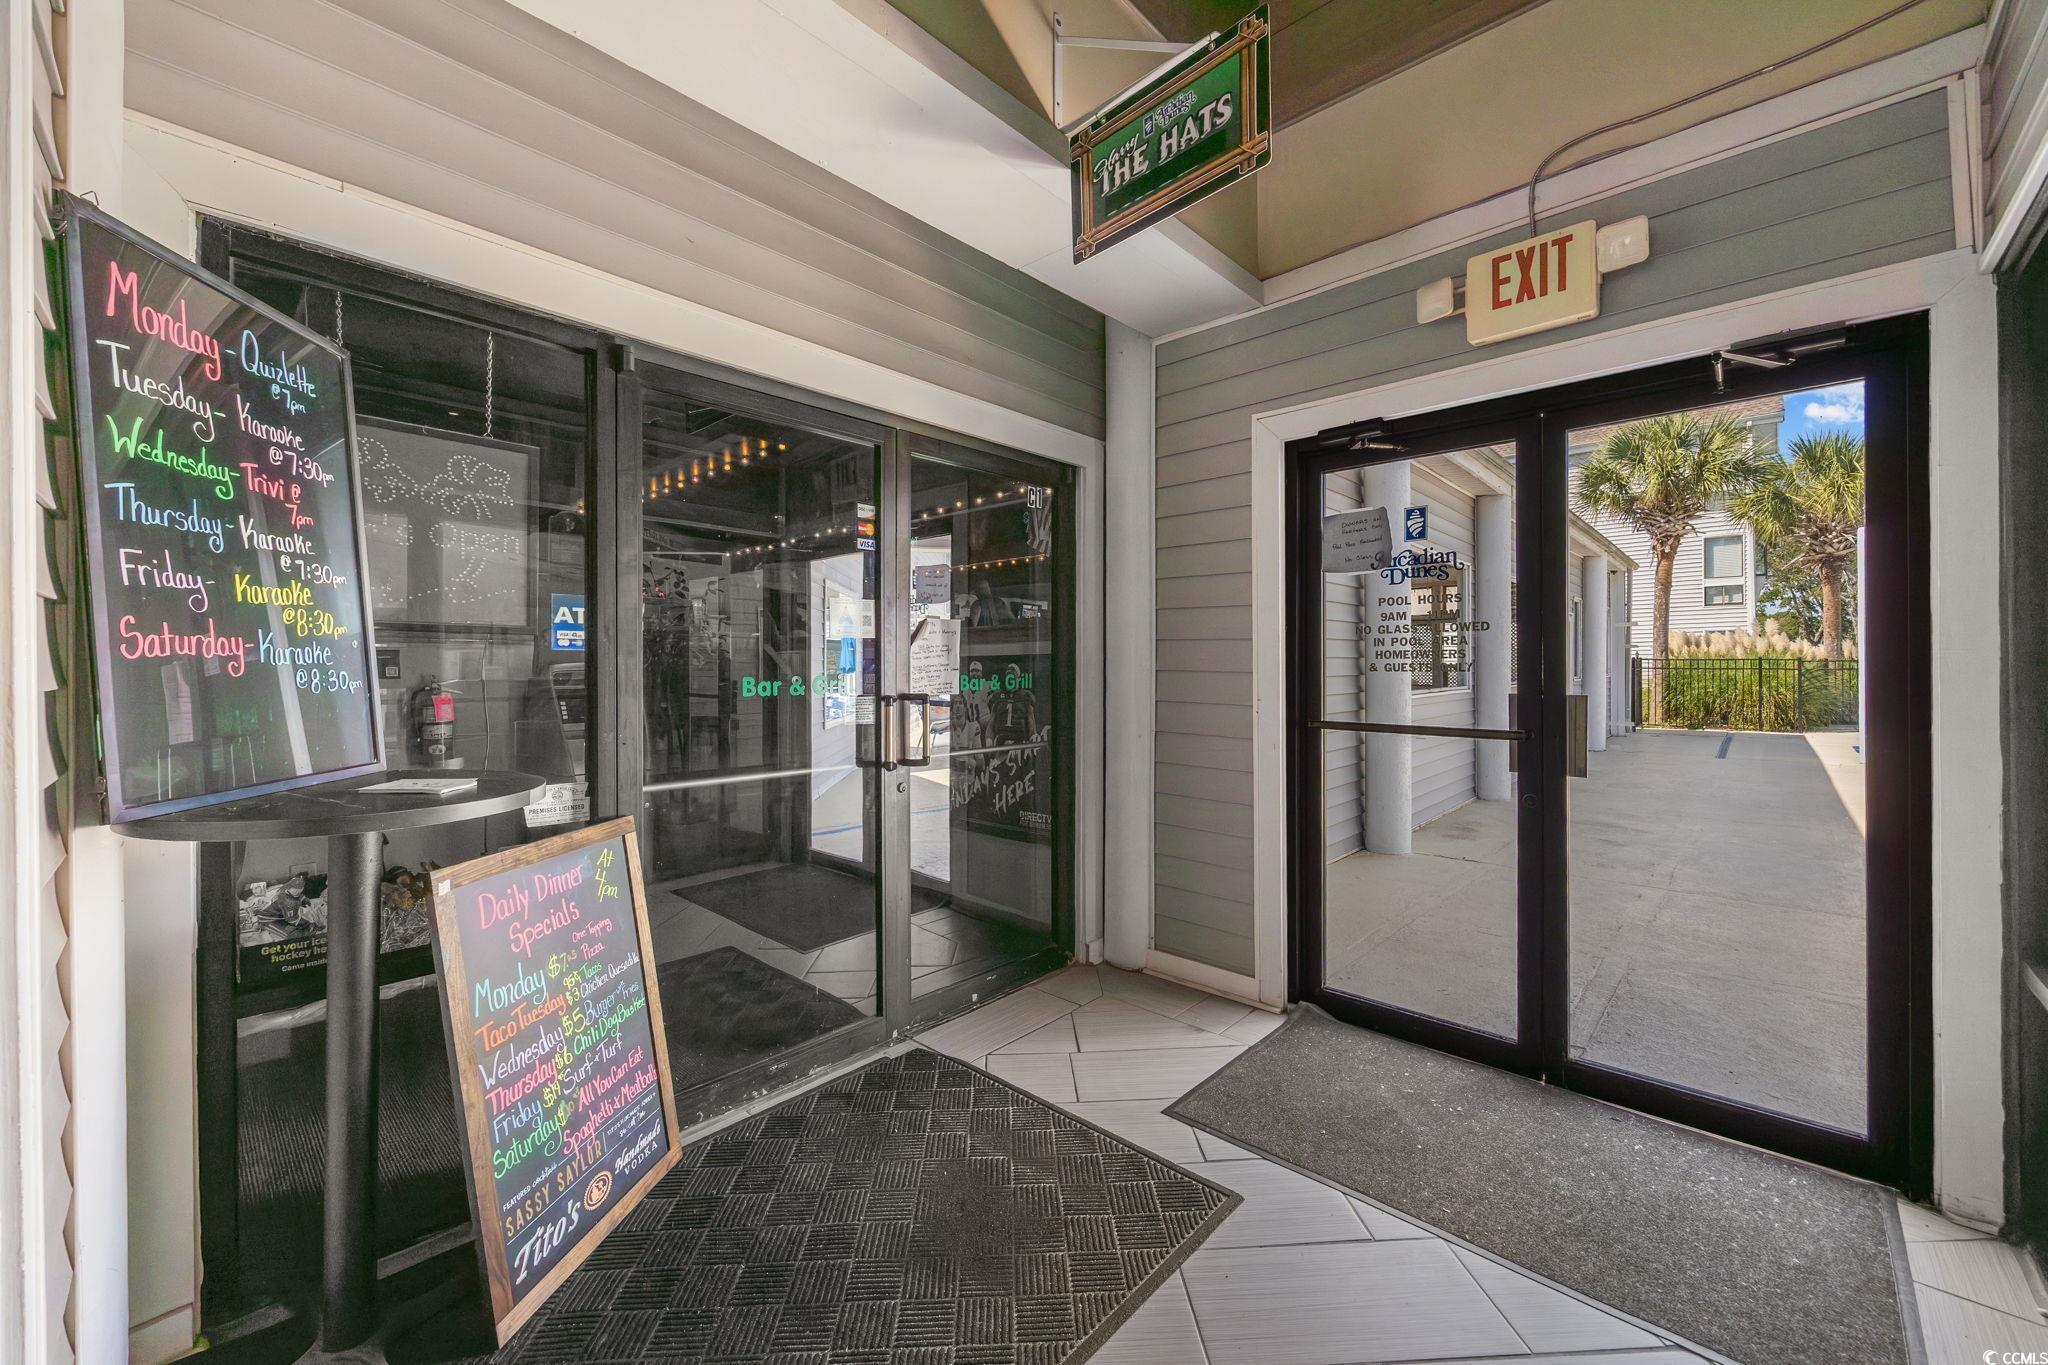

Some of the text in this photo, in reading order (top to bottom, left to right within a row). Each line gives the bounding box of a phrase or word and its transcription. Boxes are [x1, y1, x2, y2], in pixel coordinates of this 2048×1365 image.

[1101, 92, 1233, 198] THE HATS
[1491, 233, 1574, 310] EXIT
[241, 329, 316, 397] Quizlette
[236, 394, 305, 451] Karaoke
[285, 503, 313, 531] 7pm
[239, 515, 315, 555] Karaoke
[860, 541, 874, 549] VISA
[234, 574, 313, 606] Karaoke
[1381, 565, 1449, 585] Dunes
[554, 606, 585, 624] AT
[1378, 593, 1463, 606] POOL HOURS
[1355, 623, 1372, 635] NO
[1378, 624, 1418, 635] GLASS
[1380, 611, 1407, 622] 9AM
[258, 629, 334, 665] Karaoke
[1373, 635, 1468, 647] IN POOL AREA
[1375, 649, 1466, 660] HOMEOWNERS
[960, 673, 1033, 691] Bar & Grill
[1369, 662, 1473, 672] & GUESTS ONLY
[742, 676, 782, 697] Bar
[789, 675, 805, 697] &
[528, 803, 585, 815] PREMISES LICENSED
[994, 770, 1035, 816] HERE
[597, 847, 615, 867] At
[478, 864, 583, 929] Daily Dinner
[509, 898, 580, 958] Specials
[585, 918, 613, 937] Topping
[261, 944, 282, 956] Get
[283, 940, 310, 953] your
[271, 946, 328, 963] hockey he
[306, 958, 328, 967] insid
[474, 962, 547, 1018] Monday
[581, 942, 605, 960] Pizza
[565, 987, 580, 1005] $3
[474, 1020, 517, 1051] Taco
[511, 992, 567, 1030] Tuesday
[580, 962, 603, 980] Tacos
[478, 1025, 566, 1090] Wednesday
[561, 1007, 586, 1036] $5
[583, 995, 615, 1025] Burger
[485, 992, 646, 1115] Thursday $6 Chili Dog Basket
[493, 1100, 543, 1143] Friday
[563, 1052, 594, 1094] Surf
[596, 1033, 623, 1063] Turf
[493, 1114, 563, 1179] Saturday
[578, 1082, 595, 1112] All
[592, 1074, 613, 1096] You
[611, 1062, 629, 1082] Can
[628, 1045, 644, 1067] Eat
[563, 1099, 614, 1160] Spaghetti
[620, 1063, 658, 1107] Meatballs
[614, 1118, 661, 1175] Handmade
[624, 1140, 658, 1175] VODKA
[503, 1185, 531, 1212] FEATURED
[505, 1140, 602, 1237] SASSY SAYLOR
[514, 1199, 581, 1285] Tito's
